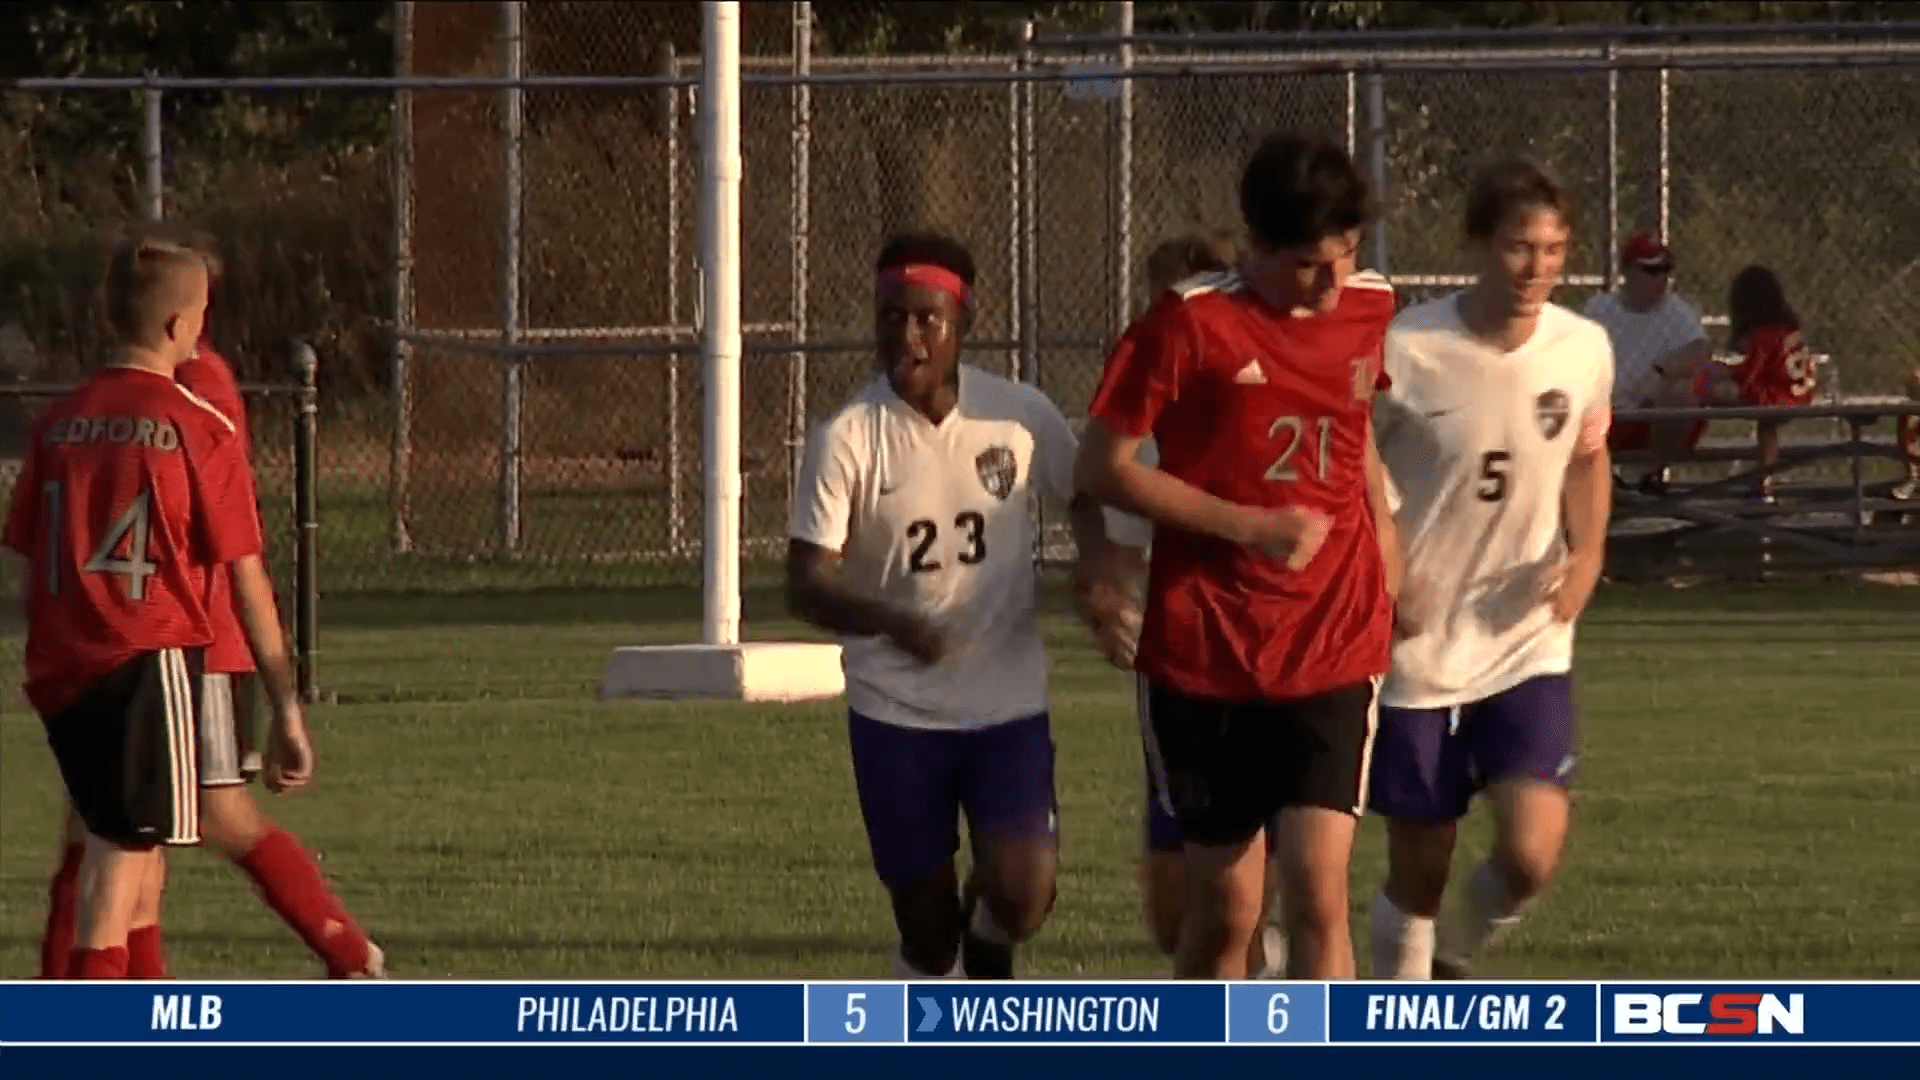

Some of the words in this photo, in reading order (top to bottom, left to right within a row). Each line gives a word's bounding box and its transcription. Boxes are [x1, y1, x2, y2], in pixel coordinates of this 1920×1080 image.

[1263, 415, 1332, 482] 21
[1477, 450, 1511, 502] 5
[43, 480, 156, 600] 14
[905, 511, 986, 572] 23
